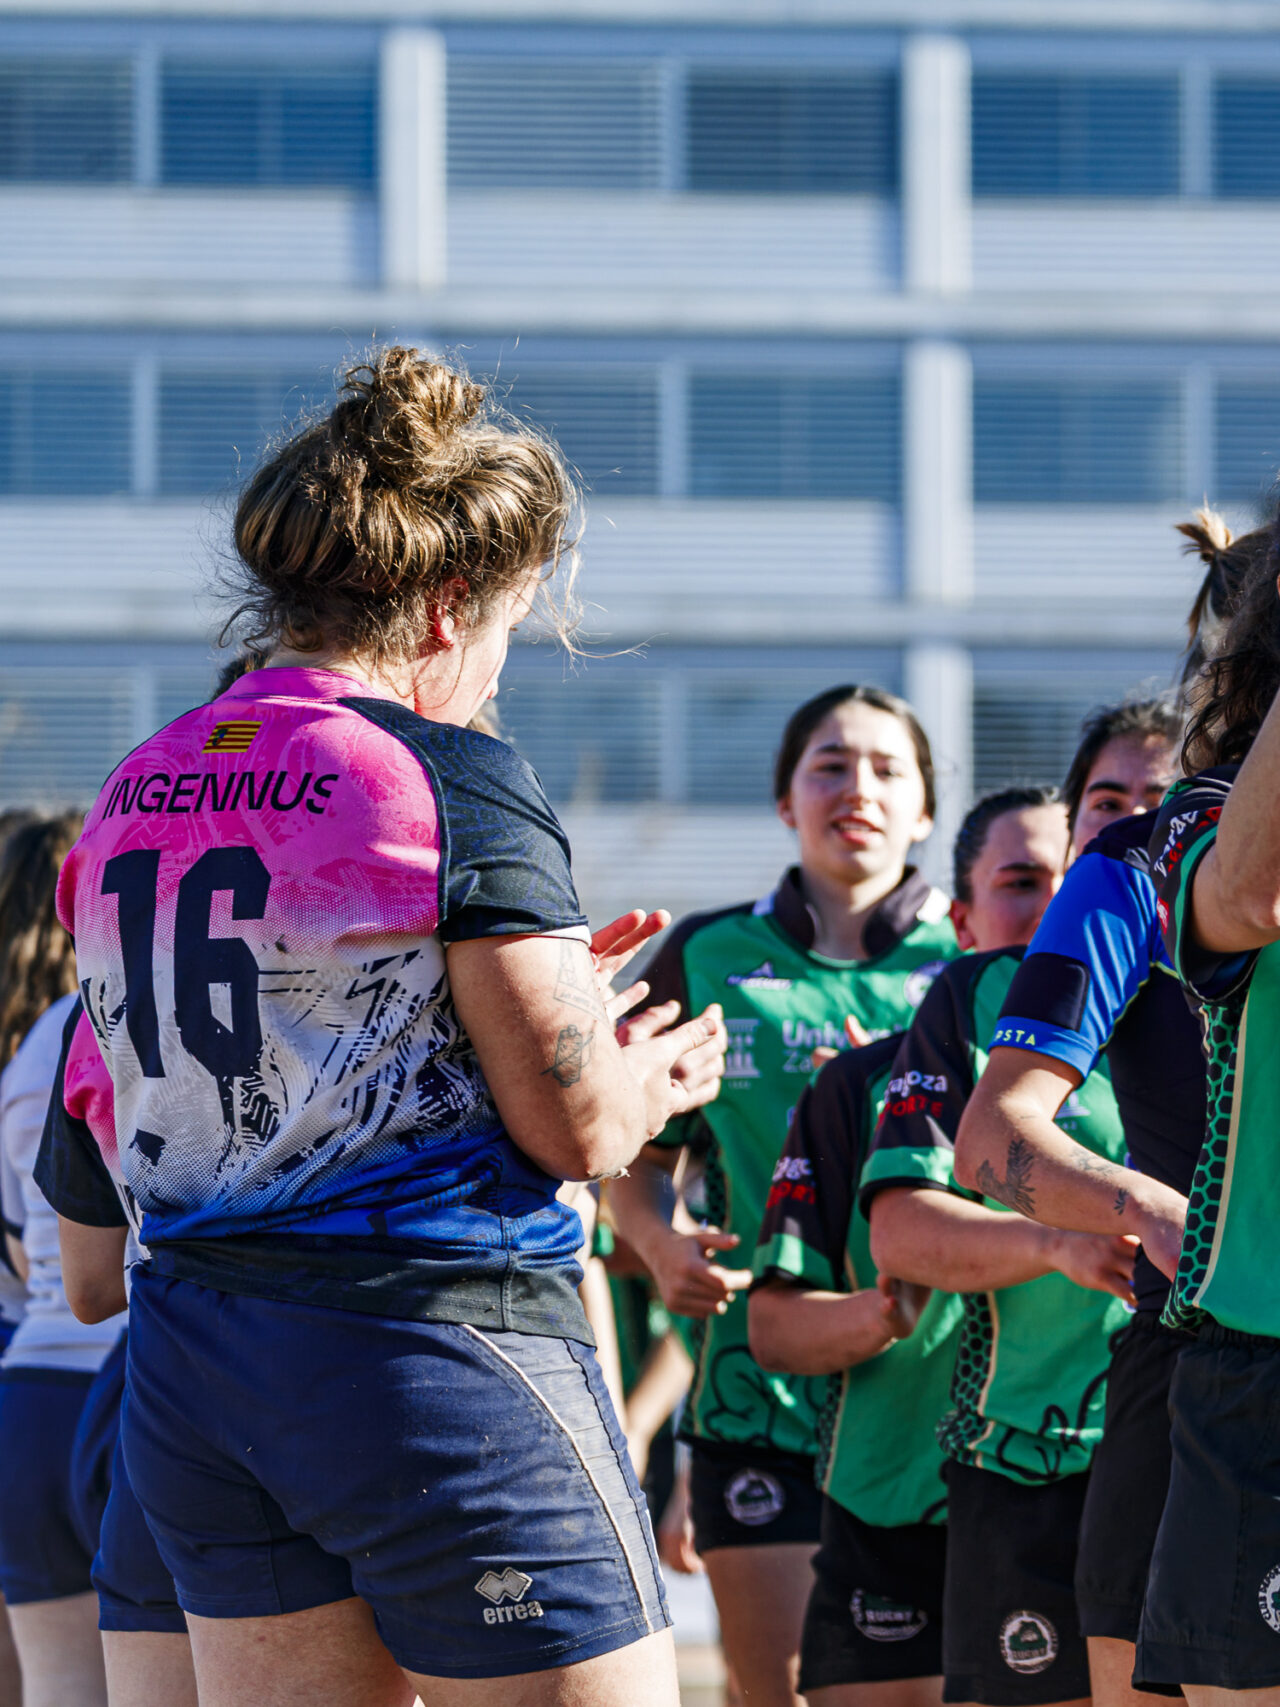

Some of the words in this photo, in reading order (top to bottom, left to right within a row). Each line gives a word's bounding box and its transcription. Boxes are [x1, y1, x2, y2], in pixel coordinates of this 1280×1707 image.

[102, 771, 340, 820] INGENNUS
[100, 846, 272, 1078] 16
[484, 1602, 544, 1624] errea
